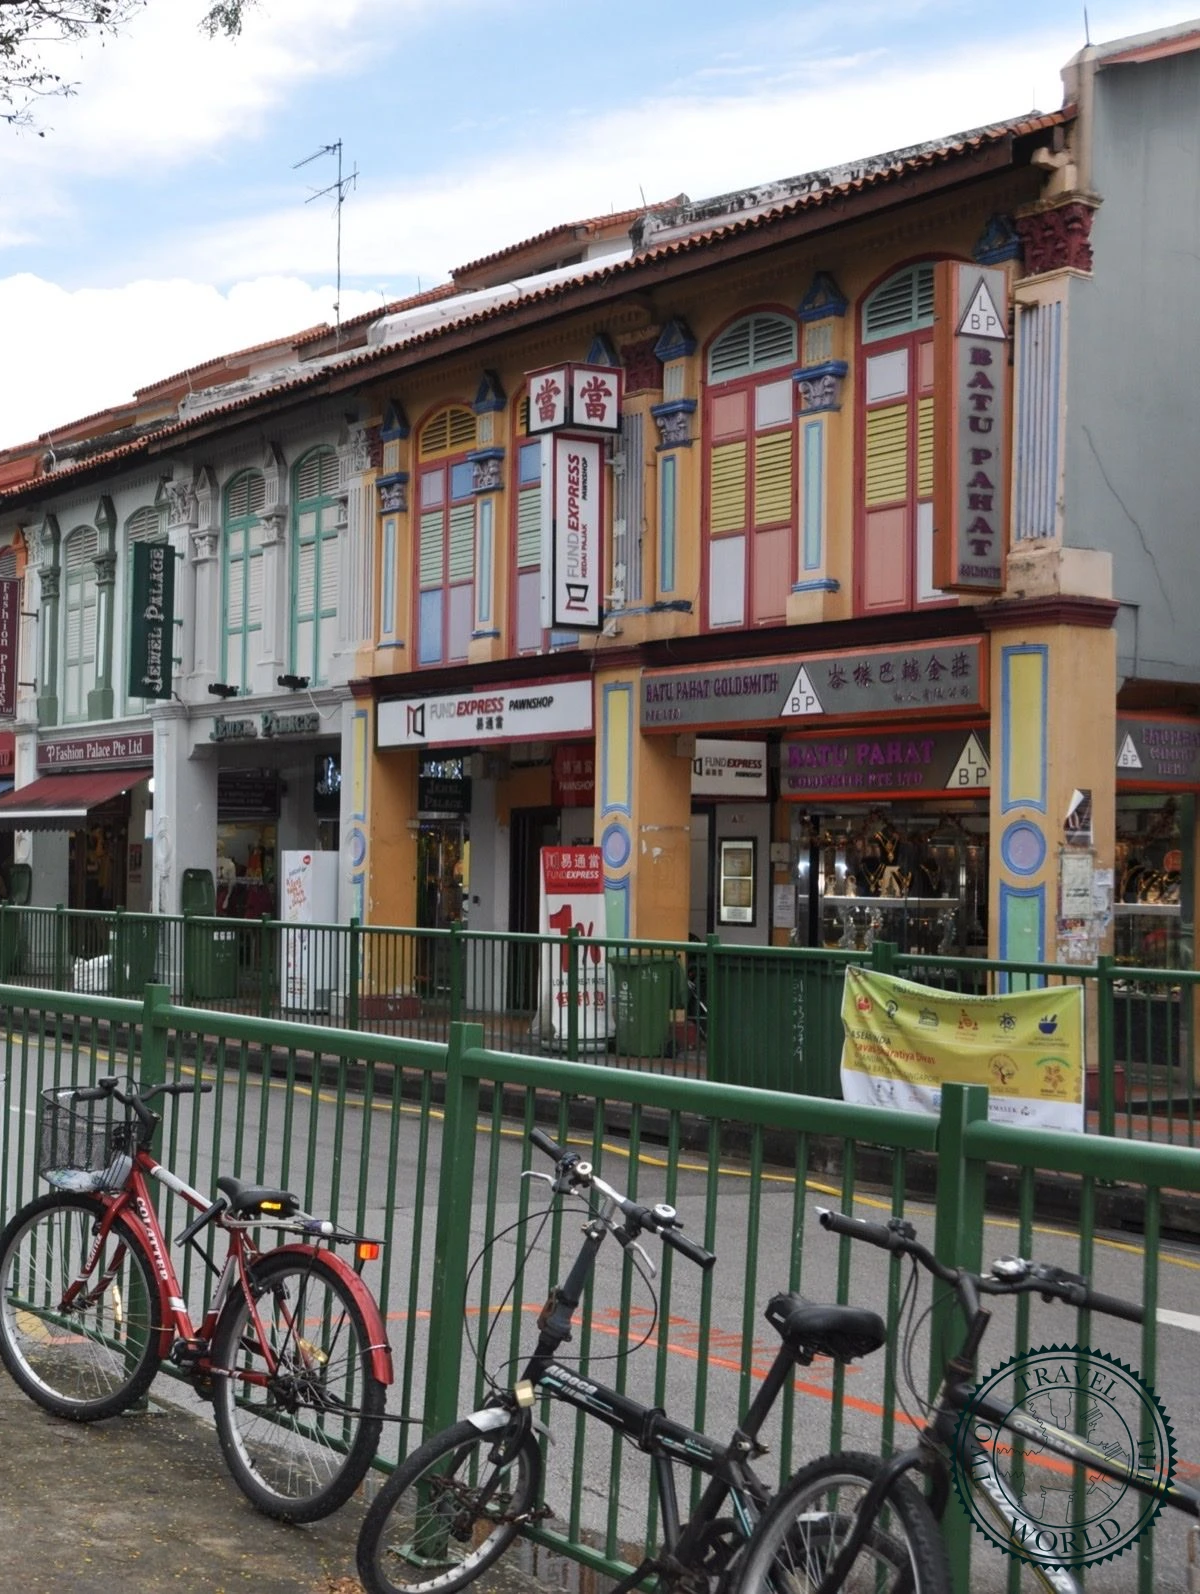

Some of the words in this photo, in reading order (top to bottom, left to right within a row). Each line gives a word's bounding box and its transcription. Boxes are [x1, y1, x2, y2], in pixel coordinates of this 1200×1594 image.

[979, 296, 987, 311] L
[535, 378, 562, 423] 當
[580, 375, 613, 422] 當
[966, 347, 995, 434] BATU
[566, 453, 580, 578] FUNDEXPRESS
[966, 448, 995, 556] PAHAT
[0, 582, 10, 646] Fashion
[0, 653, 9, 706] Palace
[645, 683, 673, 703] BATU
[676, 679, 711, 700] PAHAT
[713, 672, 779, 697] GOLDSMITH
[799, 678, 806, 695] L
[430, 696, 504, 720] FUNDEXPRESS
[508, 695, 553, 712] PAWNSHOP
[56, 744, 84, 761] Fashion
[86, 742, 111, 759] Palace
[112, 740, 126, 756] Pte
[128, 738, 142, 755] Ltd
[705, 757, 762, 769] FUNDEXPRESS
[788, 744, 848, 768] BATU
[855, 739, 935, 766] PAHAT
[968, 747, 976, 765] L
[561, 852, 601, 869] 易通當
